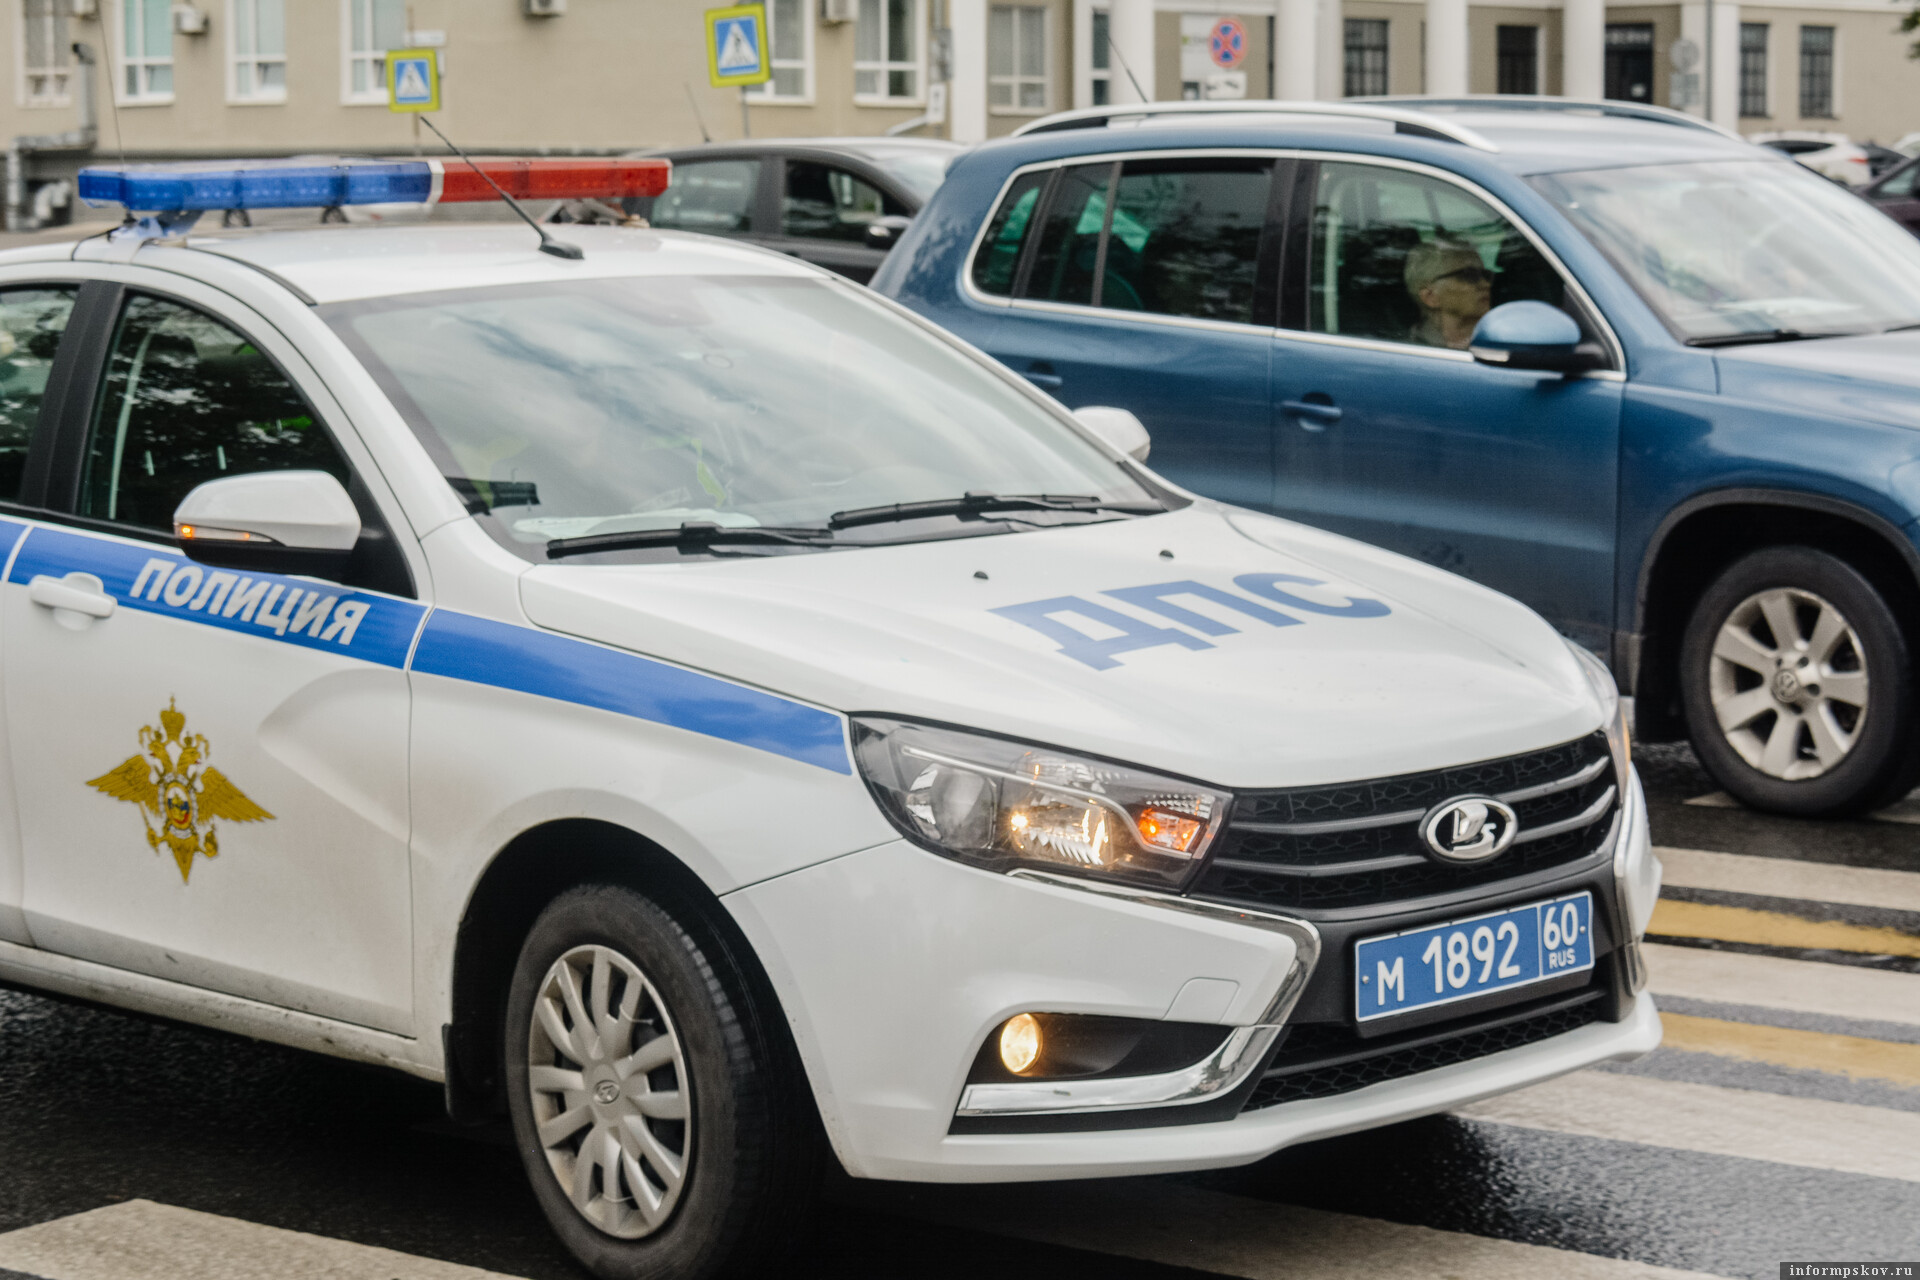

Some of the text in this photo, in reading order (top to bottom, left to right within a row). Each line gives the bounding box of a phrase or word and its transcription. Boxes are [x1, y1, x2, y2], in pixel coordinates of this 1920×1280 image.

[129, 558, 371, 645] ПОЛИЦИЯ
[985, 572, 1392, 671] ДПС
[1377, 903, 1578, 1006] М 1892 60
[1549, 948, 1576, 970] RUS
